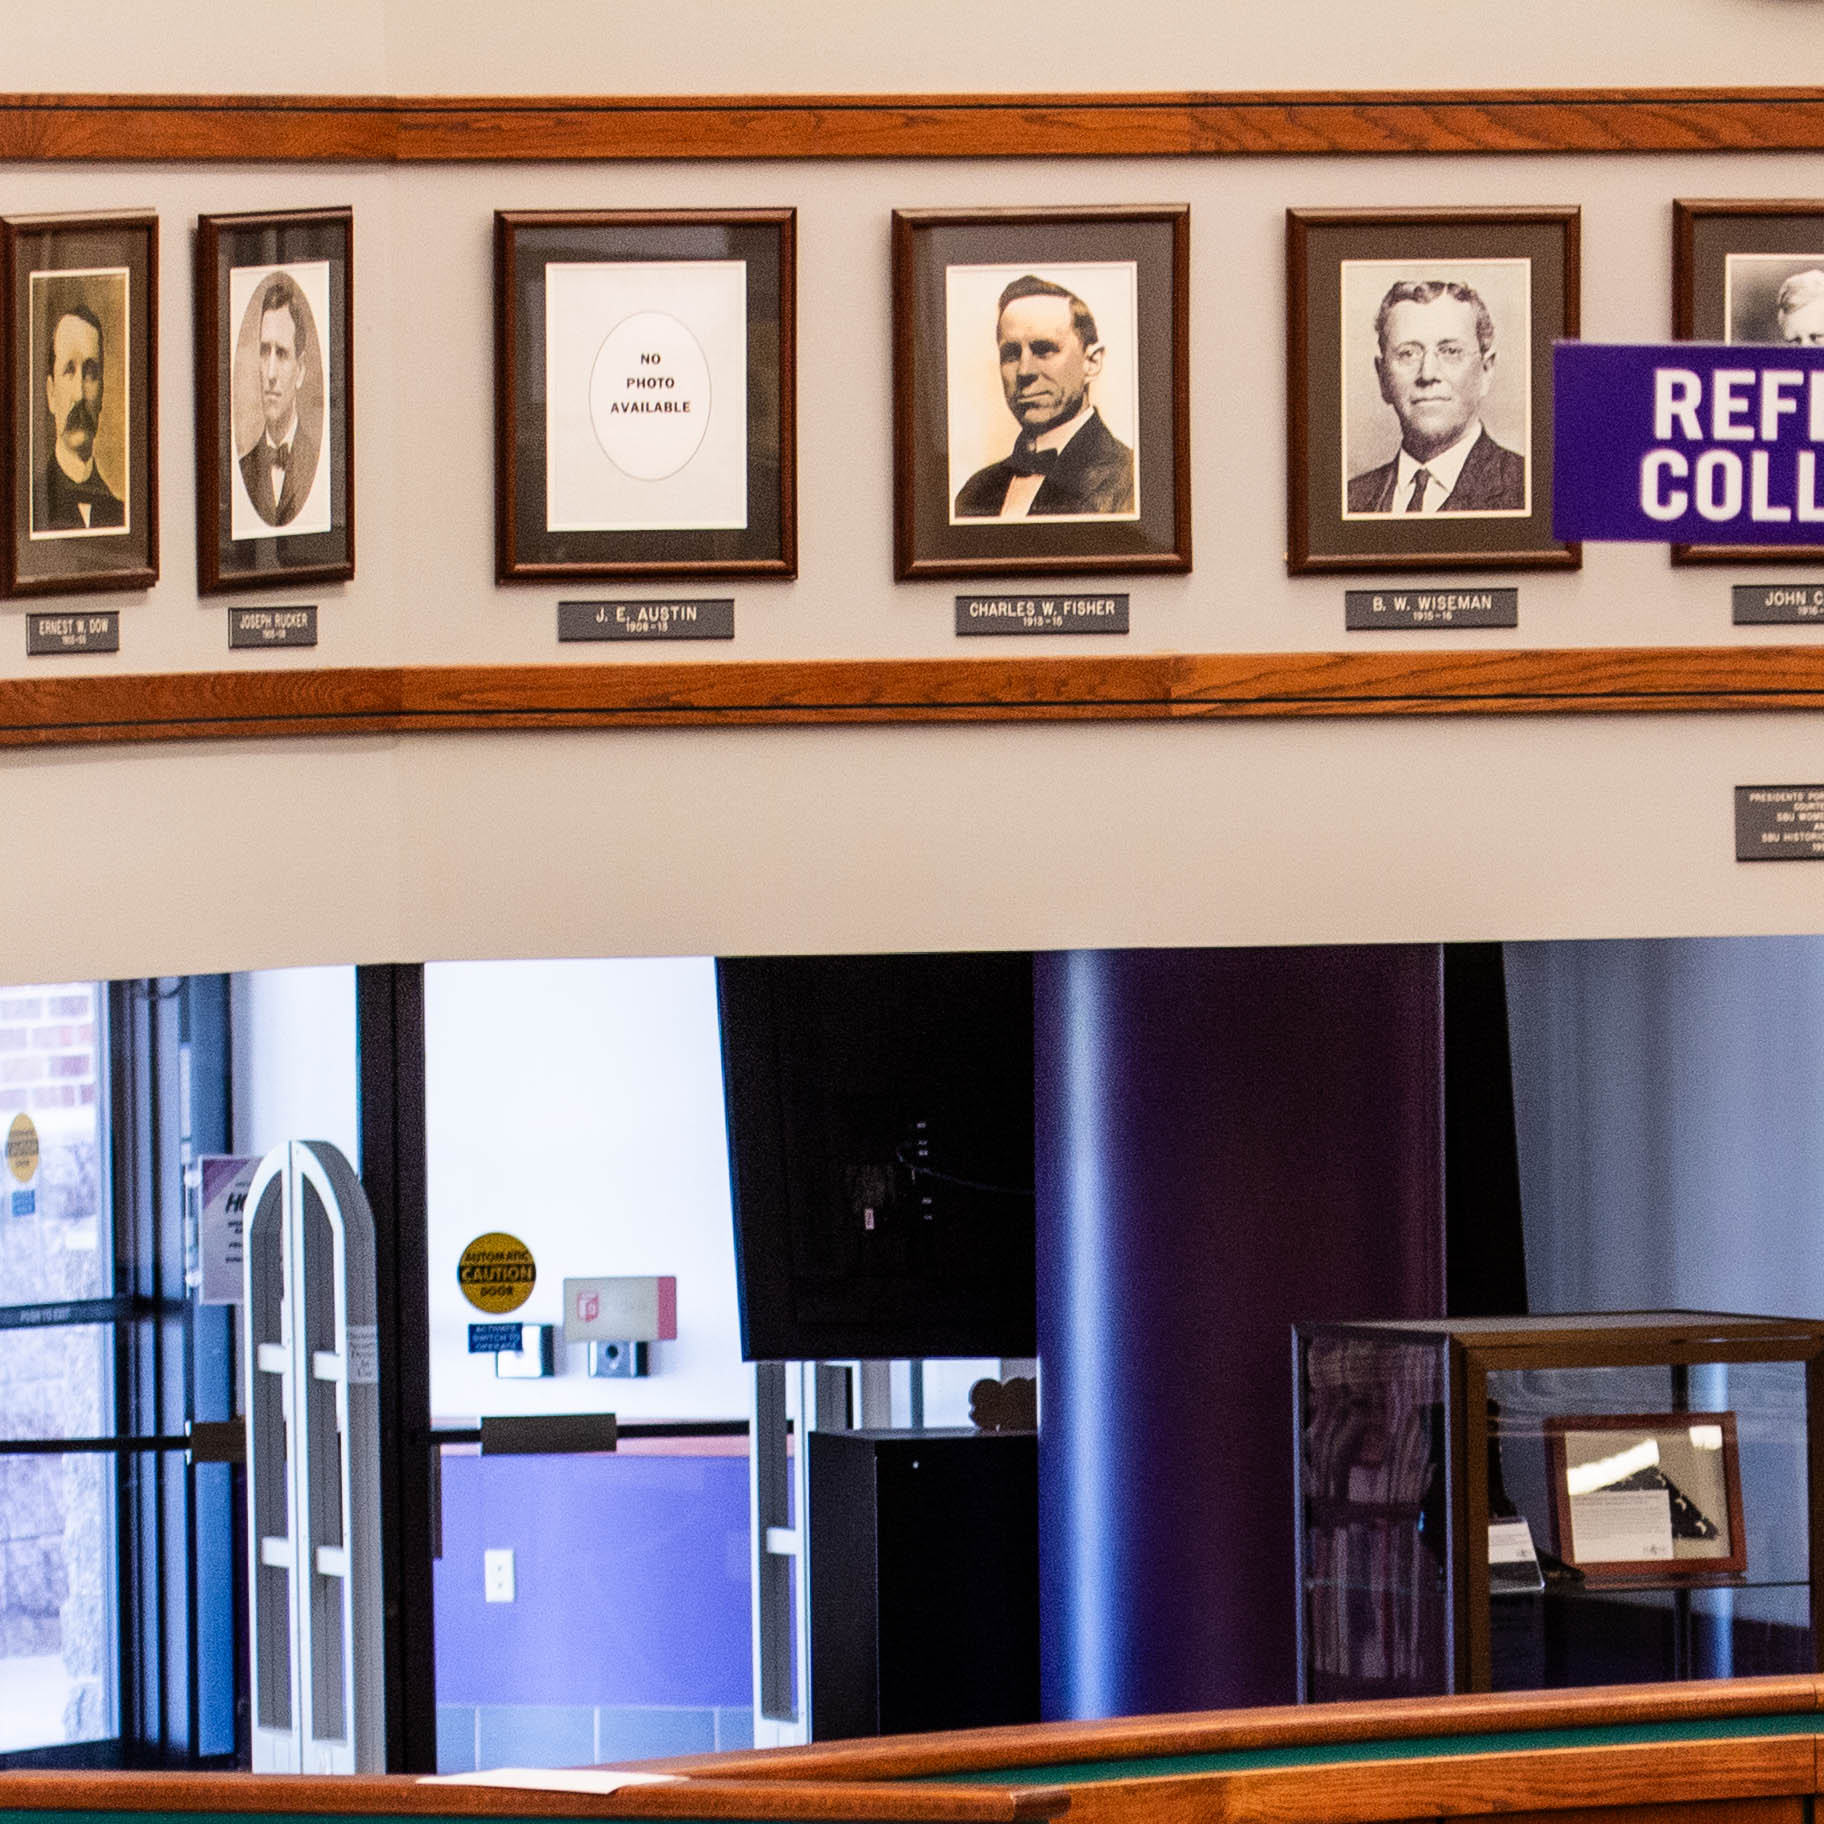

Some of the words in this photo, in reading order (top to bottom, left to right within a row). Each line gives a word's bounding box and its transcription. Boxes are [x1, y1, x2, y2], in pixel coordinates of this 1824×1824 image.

[640, 353, 662, 365] NO
[626, 377, 676, 390] PHOTO
[610, 401, 692, 414] AVAILABLE
[1371, 596, 1387, 612] B.
[1393, 596, 1412, 612] W.
[1417, 594, 1494, 612] WISEMAN
[1764, 590, 1808, 607] JOHN
[595, 607, 610, 623] J.
[637, 605, 698, 622] AUSTIN
[968, 601, 1037, 618] CHARLES
[1063, 599, 1117, 616] FISHER
[38, 619, 75, 636] ERNEST
[89, 617, 110, 634] DOW
[239, 612, 273, 630] JOSEPH
[274, 611, 309, 629] RUCKER
[464, 1250, 530, 1263] AUTOMATIC
[460, 1264, 533, 1282] CAUTION
[479, 1284, 514, 1297] DOOR
